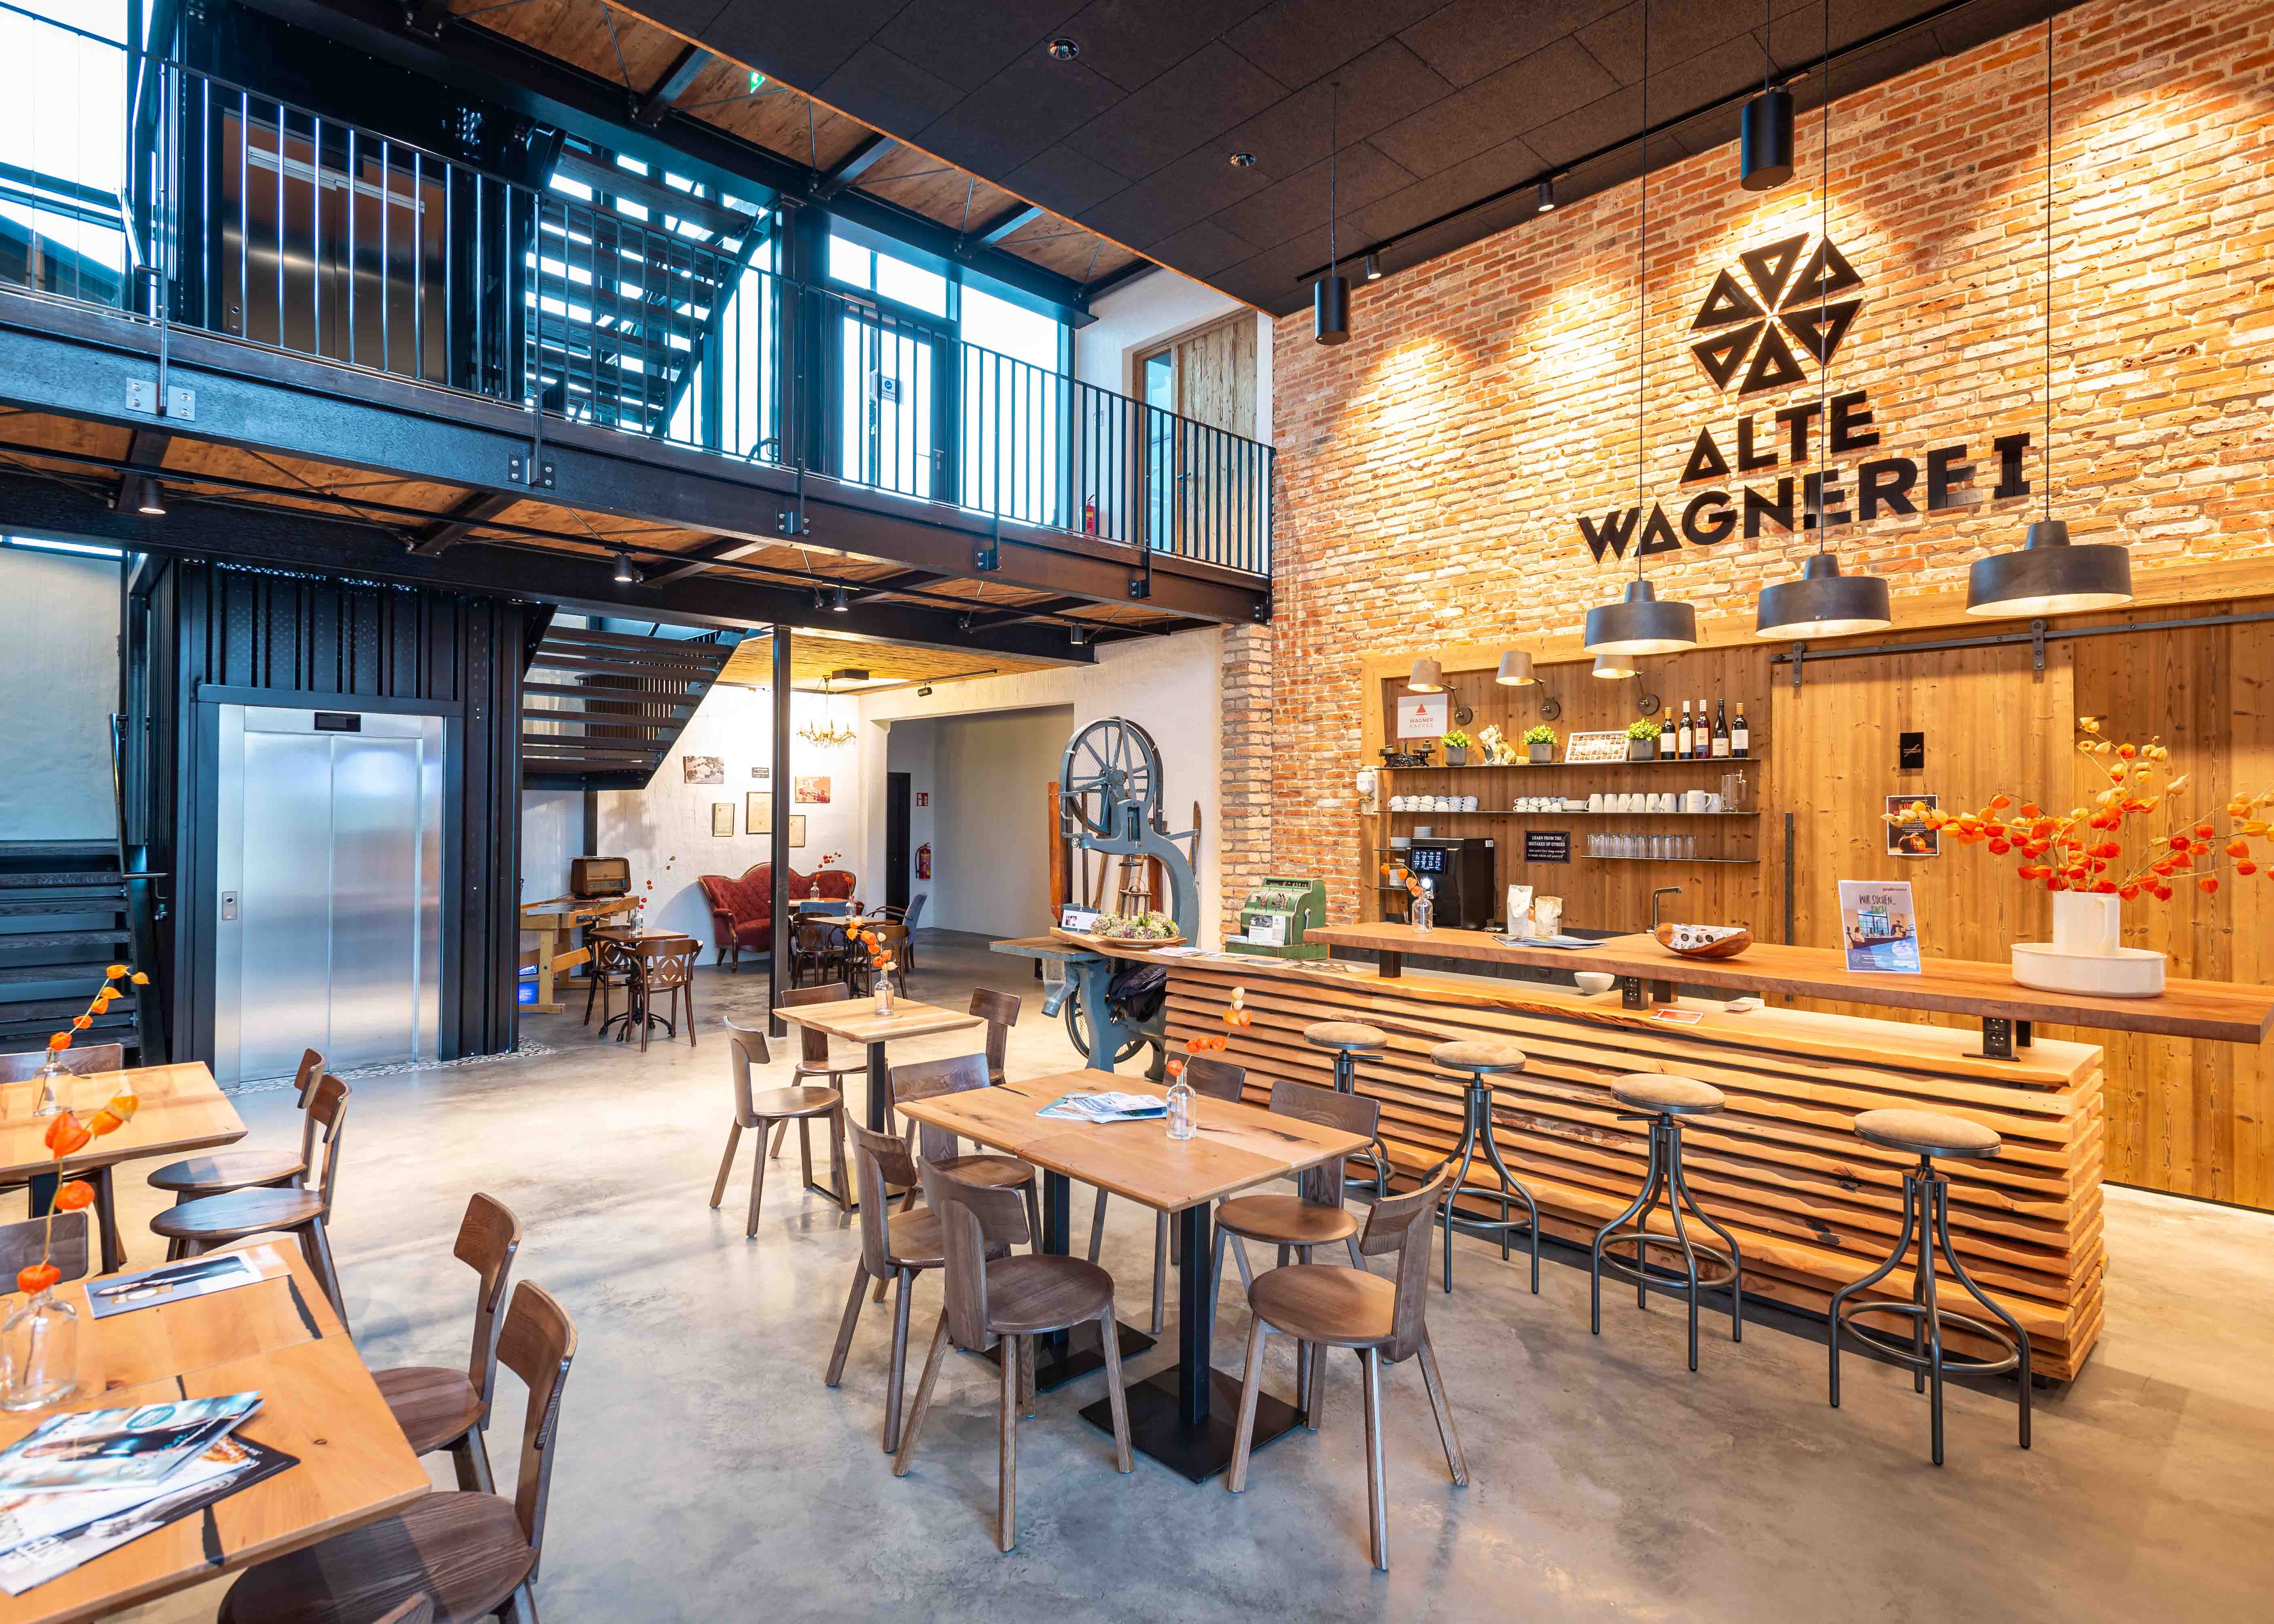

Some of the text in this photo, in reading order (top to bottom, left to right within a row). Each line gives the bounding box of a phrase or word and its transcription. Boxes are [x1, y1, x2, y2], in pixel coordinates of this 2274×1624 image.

[1680, 389, 1880, 484] ALTE
[1577, 432, 2031, 565] WAGNEREI
[1859, 894, 1871, 905] WIR
